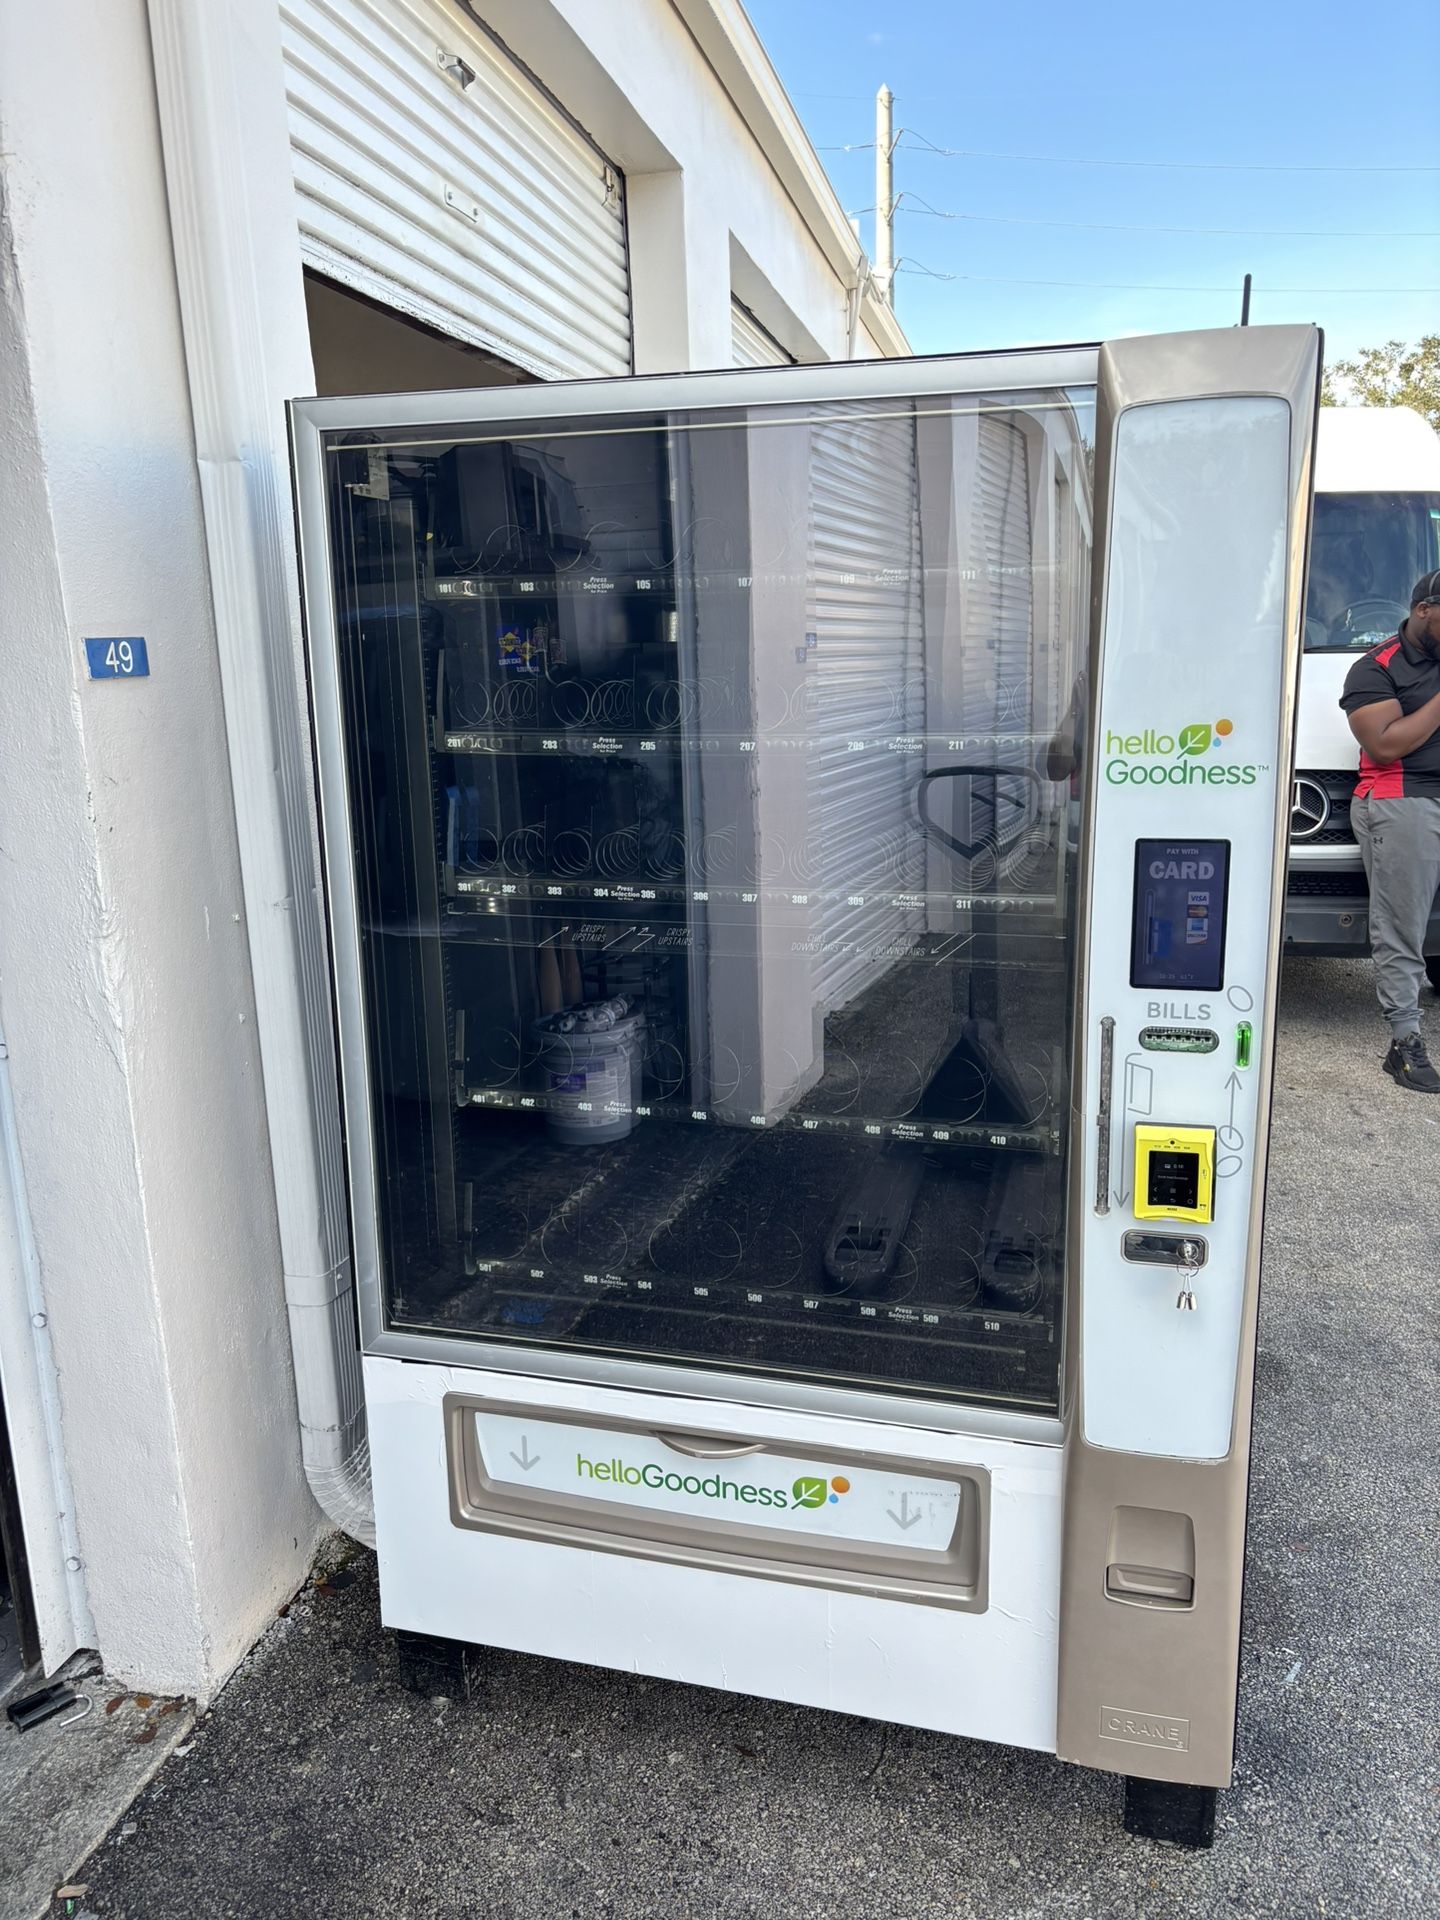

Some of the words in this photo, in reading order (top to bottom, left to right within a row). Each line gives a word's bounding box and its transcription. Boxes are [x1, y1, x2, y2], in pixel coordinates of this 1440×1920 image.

[839, 573, 855, 585] 109
[961, 570, 976, 580] 111
[519, 582, 534, 592] 103
[583, 582, 614, 590] Selection
[636, 579, 651, 590] 105
[738, 577, 753, 588] 107
[438, 583, 452, 593] 101
[105, 640, 134, 673] 49
[447, 738, 462, 748] 201
[542, 740, 558, 750] 203
[592, 742, 623, 750] Selection
[640, 741, 656, 751] 205
[739, 741, 756, 752] 207
[848, 741, 864, 751] 209
[887, 742, 923, 750] Selection
[948, 740, 964, 750] 211
[1106, 729, 1175, 755] hello
[1149, 860, 1215, 880] CARD
[457, 882, 472, 892] 301
[501, 884, 517, 894] 302
[547, 886, 562, 896] 303
[593, 887, 609, 897] 304
[610, 890, 640, 898] Selection
[640, 889, 656, 899] 305
[693, 891, 709, 901] 306
[742, 893, 758, 903] 307
[792, 895, 808, 904] 308
[847, 896, 864, 906] 309
[891, 899, 925, 907] Selection
[956, 899, 971, 909] 311
[580, 924, 605, 933] CRISPY
[666, 927, 690, 937] CRISPY
[571, 932, 607, 943] UPSTAIRS
[657, 935, 693, 946] UPSTAIRS
[875, 945, 926, 957] DOWNSTAIRS
[1147, 1002, 1212, 1021] BILLS
[472, 1094, 486, 1103] 401
[520, 1098, 535, 1107] 402
[577, 1102, 592, 1112] 403
[636, 1106, 651, 1116] 404
[692, 1111, 707, 1121] 405
[750, 1115, 766, 1125] 406
[802, 1119, 818, 1130] 407
[865, 1124, 881, 1135] 408
[898, 1123, 917, 1131] Press
[891, 1128, 924, 1137] Selection
[932, 1130, 949, 1140] 409
[990, 1135, 1007, 1145] 410
[479, 1263, 492, 1272] 501
[530, 1269, 544, 1279] 502
[584, 1274, 598, 1284] 503
[638, 1280, 652, 1290] 504
[694, 1286, 709, 1297] 505
[747, 1292, 763, 1303] 506
[803, 1300, 819, 1310] 507
[894, 1306, 912, 1314] Press
[860, 1306, 876, 1316] 508
[887, 1311, 920, 1321] Selection
[923, 1313, 939, 1324] 509
[984, 1320, 1000, 1331] 510
[576, 1452, 788, 1509] helloGoodness
[1107, 1717, 1180, 1742] CRANE
